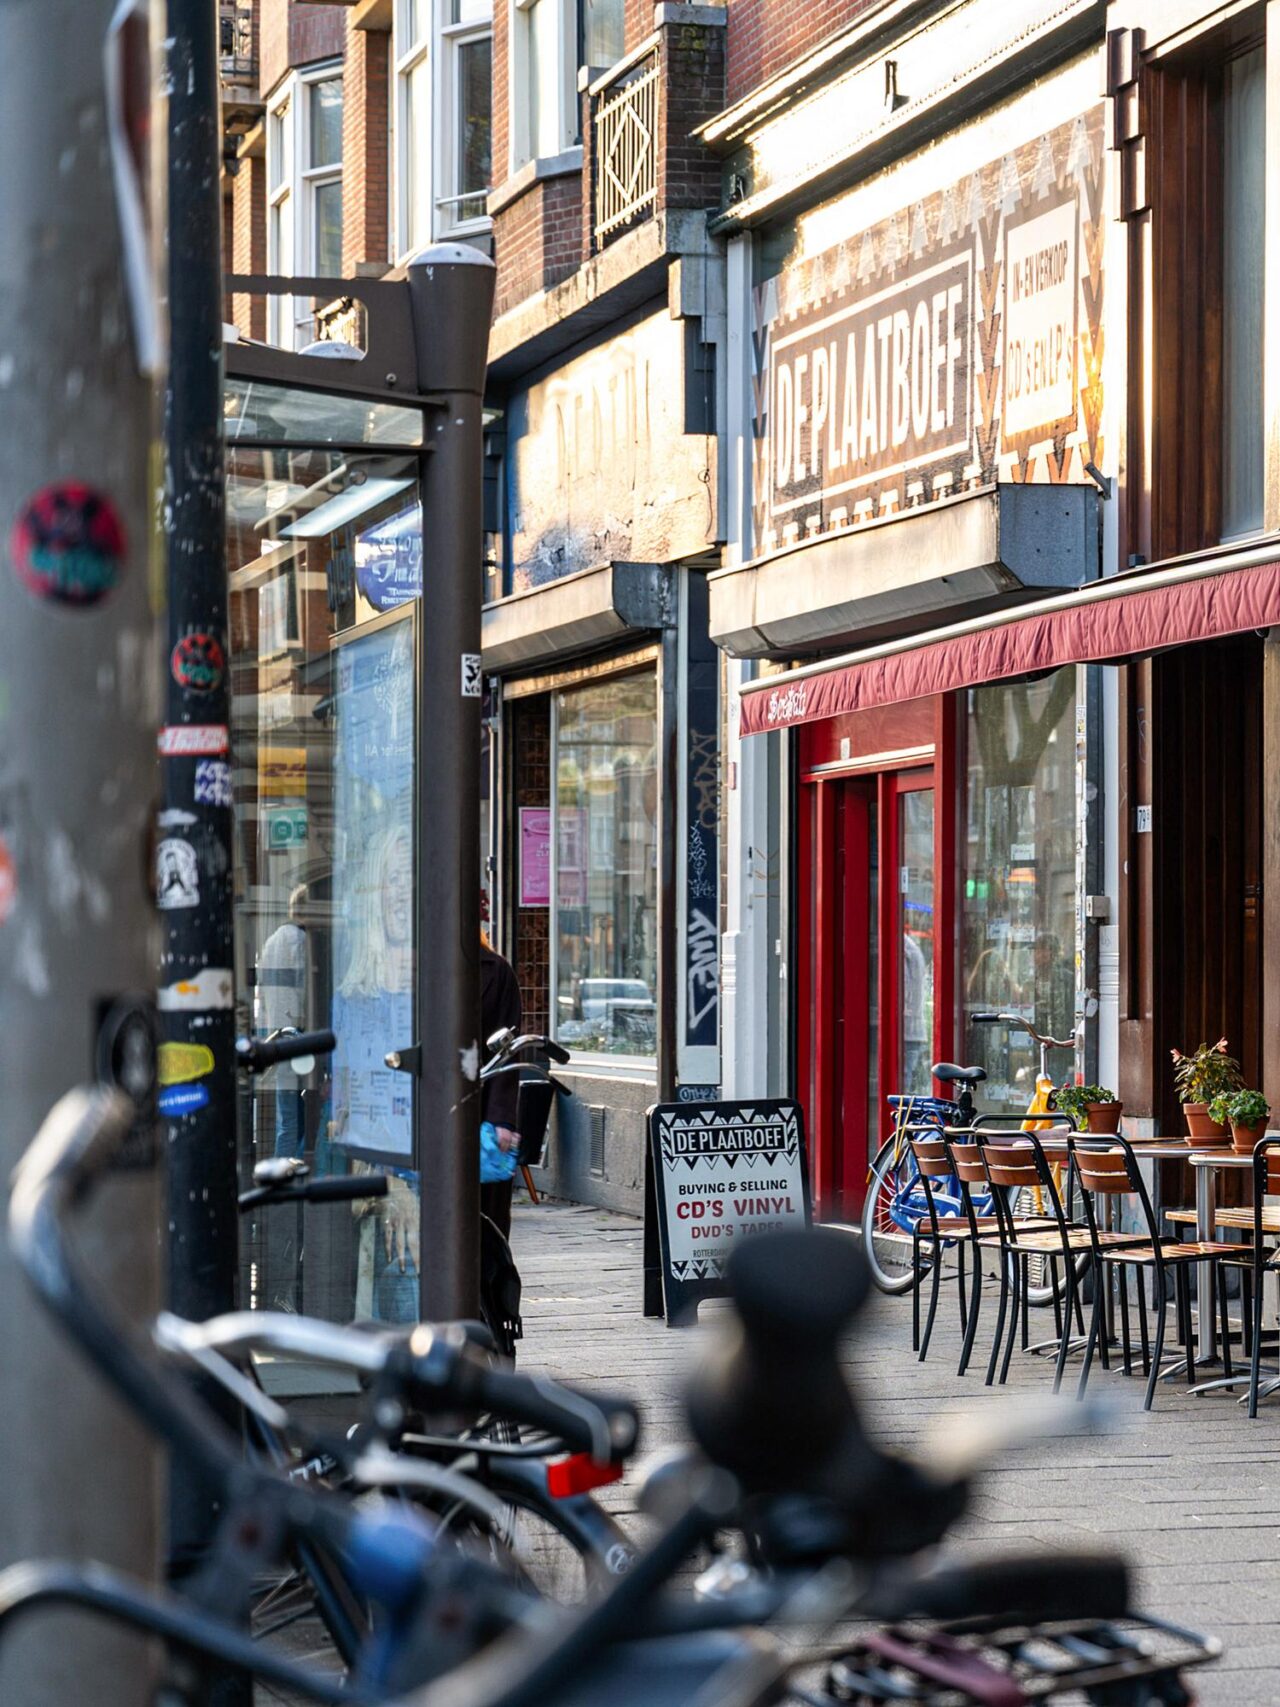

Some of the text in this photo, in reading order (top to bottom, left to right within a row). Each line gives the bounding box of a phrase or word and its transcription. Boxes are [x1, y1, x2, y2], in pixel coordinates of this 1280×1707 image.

[1025, 255, 1035, 298] EN
[1036, 239, 1068, 293] VERKOOP
[777, 353, 808, 489] DE
[811, 283, 963, 476] PLAATBOEF
[676, 1127, 782, 1152] DE PLAATBOEF
[678, 1179, 788, 1196] BUYING & SELLING
[676, 1196, 796, 1220] CD'S VINYL
[691, 1224, 734, 1239] DVD'S
